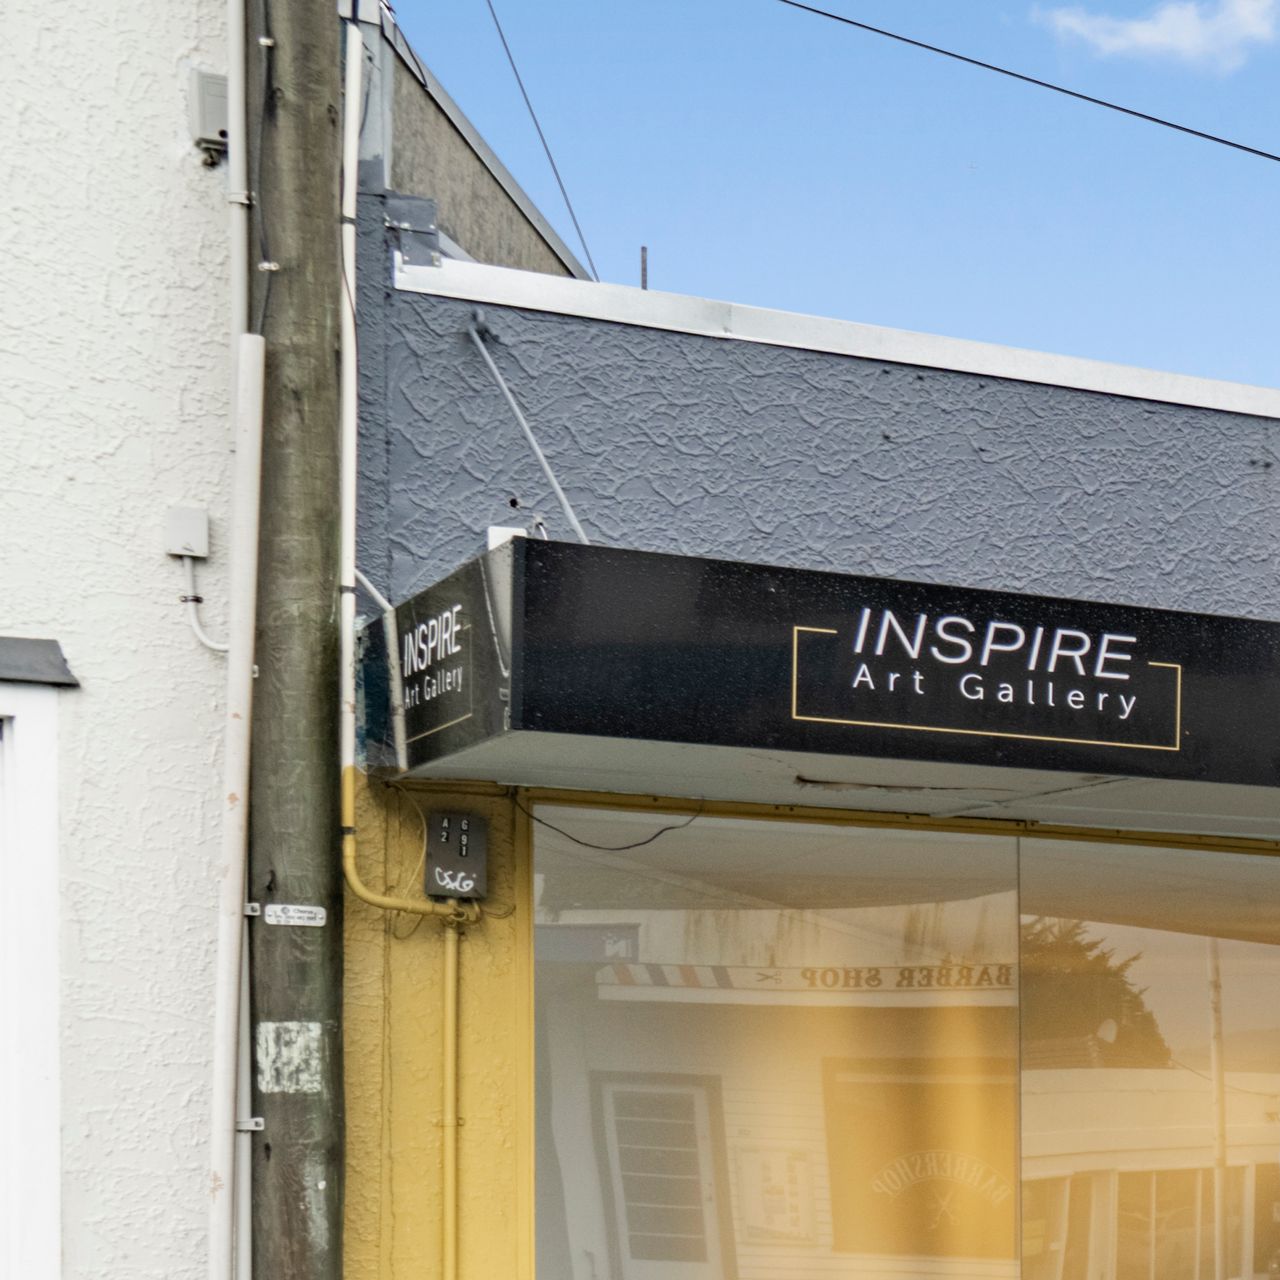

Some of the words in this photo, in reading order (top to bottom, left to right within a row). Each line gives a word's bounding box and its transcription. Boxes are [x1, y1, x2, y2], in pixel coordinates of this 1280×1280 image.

[404, 604, 462, 678] INSPIRE
[853, 606, 1138, 681] INSPIRE
[404, 684, 421, 710] Art
[424, 666, 463, 701] Gallery
[852, 663, 925, 695] Art
[959, 673, 1137, 720] Gallery
